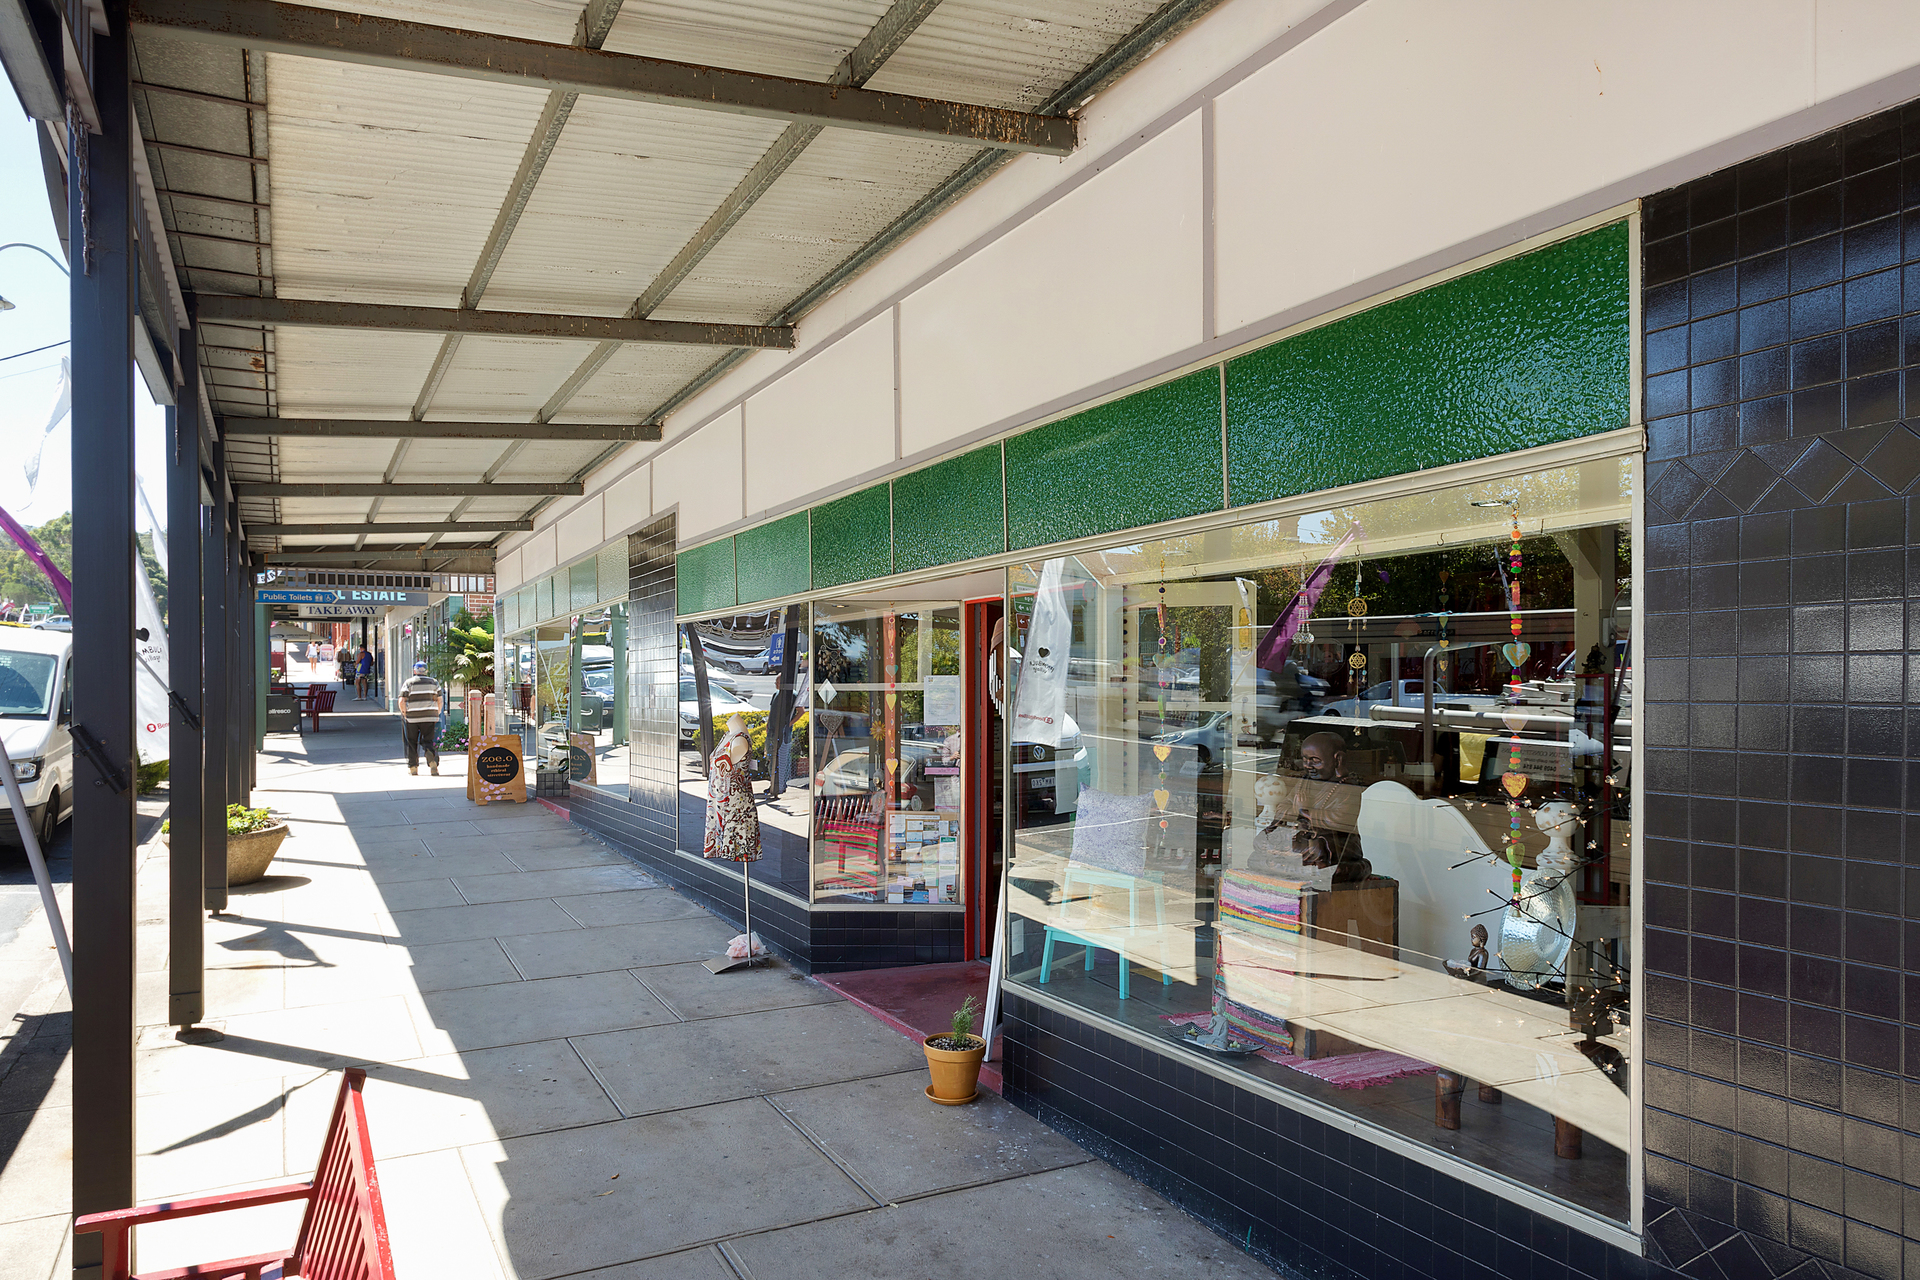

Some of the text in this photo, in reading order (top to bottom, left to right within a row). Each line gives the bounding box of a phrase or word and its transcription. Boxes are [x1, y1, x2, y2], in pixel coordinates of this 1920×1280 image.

[263, 593, 313, 601] Public Toilets
[306, 606, 378, 615] TAKE AWAY
[481, 755, 513, 763] zoe.o
